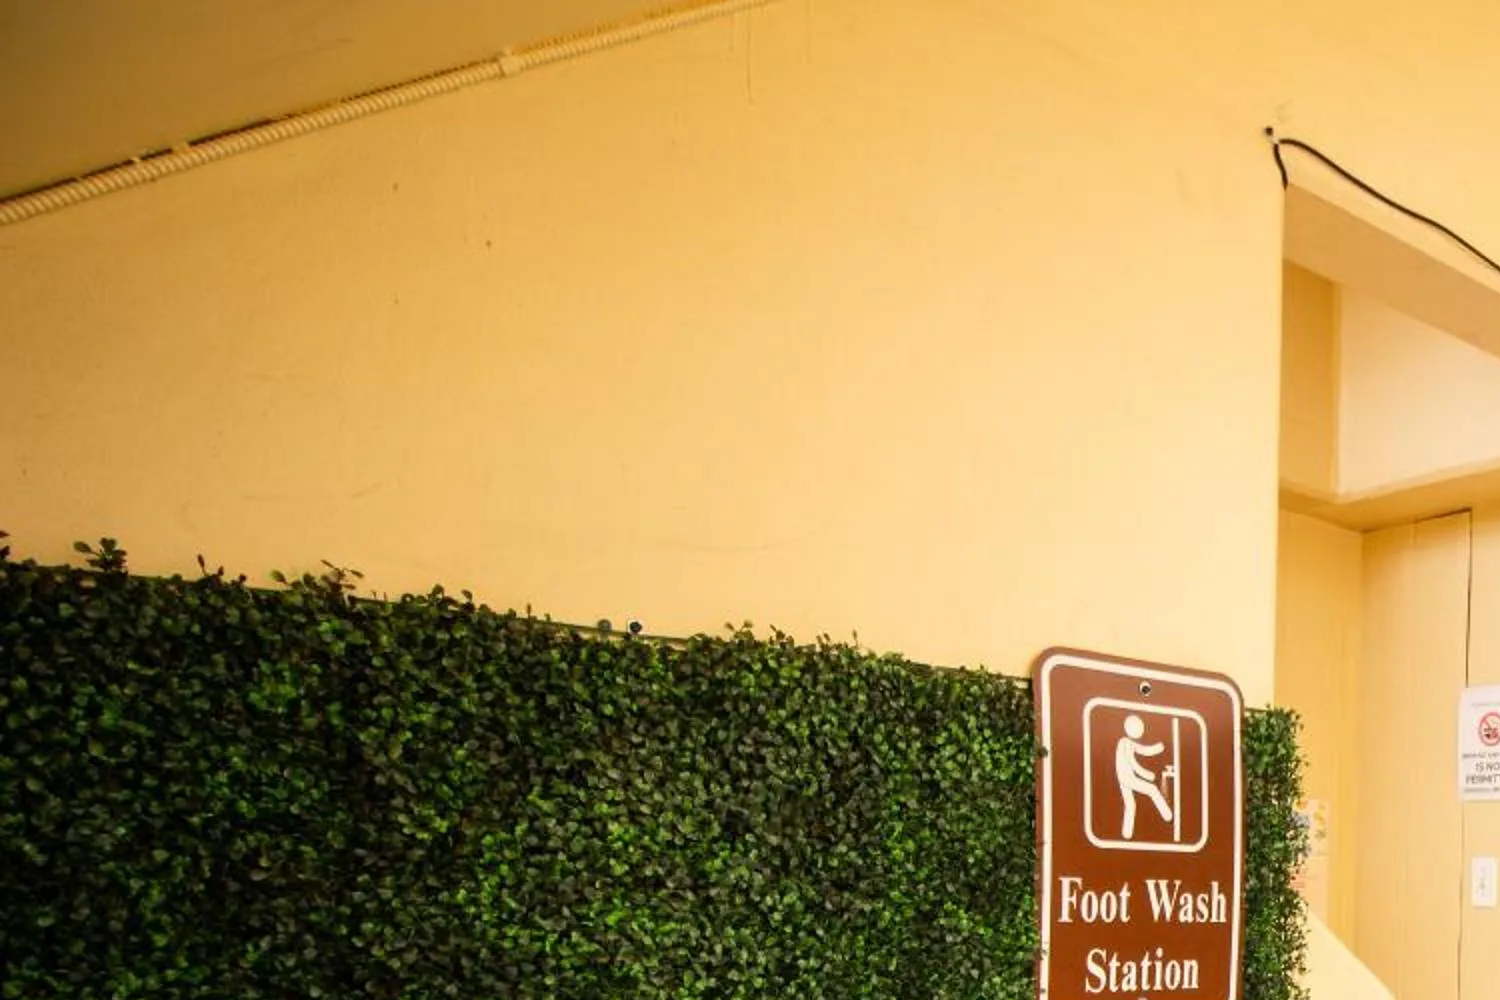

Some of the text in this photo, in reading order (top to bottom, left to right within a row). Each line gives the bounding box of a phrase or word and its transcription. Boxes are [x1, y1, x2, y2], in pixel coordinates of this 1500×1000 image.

[1057, 876, 1227, 923] Foot Wash
[1085, 947, 1199, 993] Station
